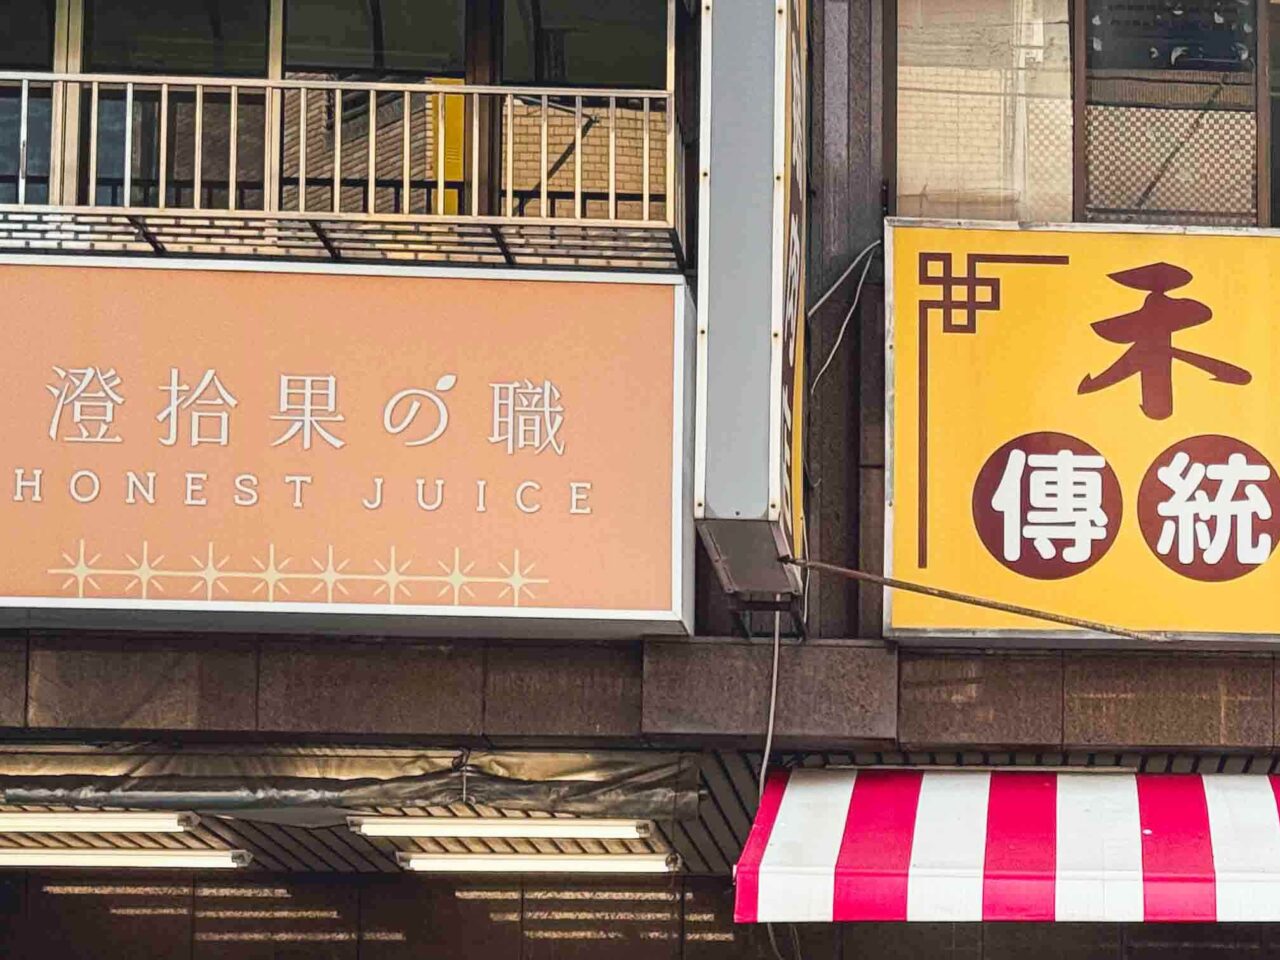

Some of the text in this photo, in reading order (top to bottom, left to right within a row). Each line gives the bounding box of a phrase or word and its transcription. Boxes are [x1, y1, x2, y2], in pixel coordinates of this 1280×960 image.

[45, 366, 565, 456] 澄拾果の職
[13, 468, 593, 514] HONEST JUICE
